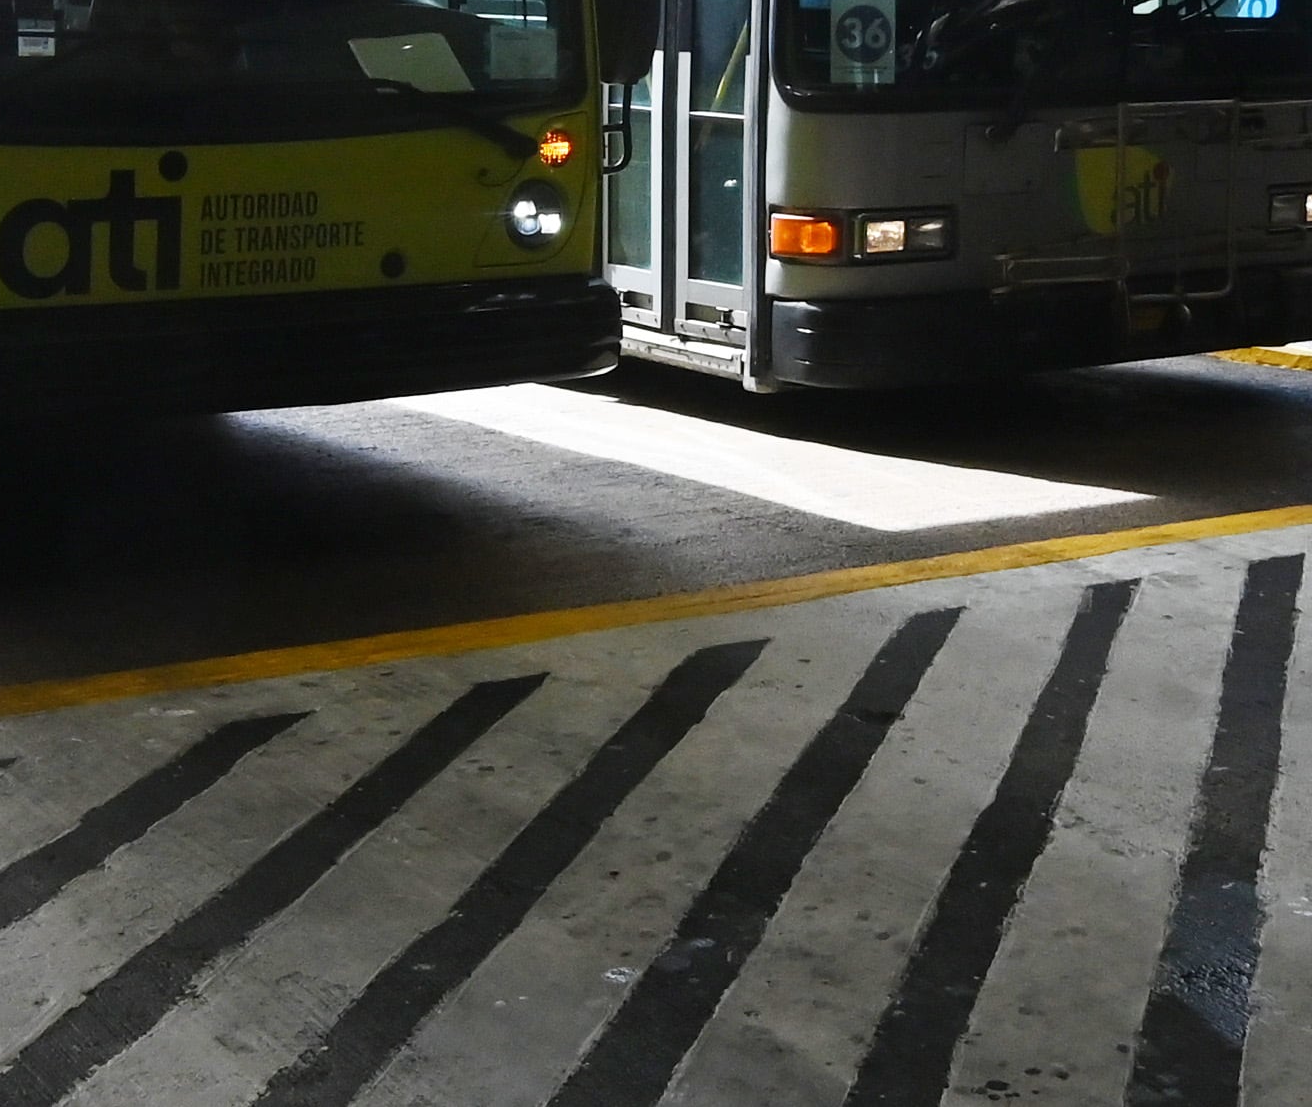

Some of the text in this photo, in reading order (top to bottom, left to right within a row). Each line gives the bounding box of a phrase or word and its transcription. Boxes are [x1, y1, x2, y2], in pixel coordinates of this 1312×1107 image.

[841, 17, 887, 49] 36
[200, 192, 319, 222] AUTORIDAD
[200, 222, 365, 254] DE TRANSPORTE
[200, 257, 317, 288] INTEGRADO
